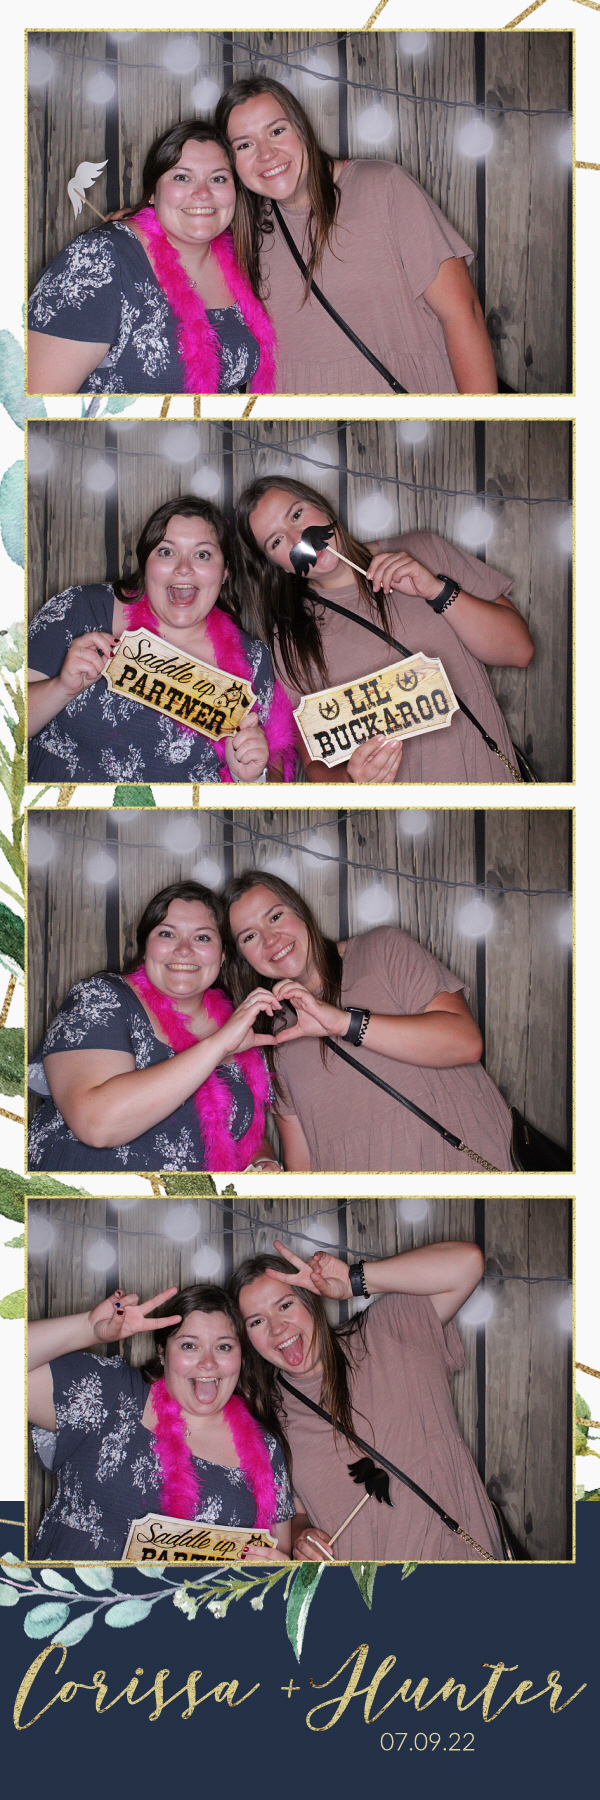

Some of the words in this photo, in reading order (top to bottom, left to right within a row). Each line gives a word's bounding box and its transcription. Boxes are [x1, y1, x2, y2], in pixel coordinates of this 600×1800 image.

[122, 638, 196, 684] Saddle
[192, 679, 216, 699] up
[114, 664, 227, 735] PARTNER
[343, 674, 393, 716] LIL'
[136, 1522, 212, 1549] Saddle
[212, 1539, 238, 1557] up
